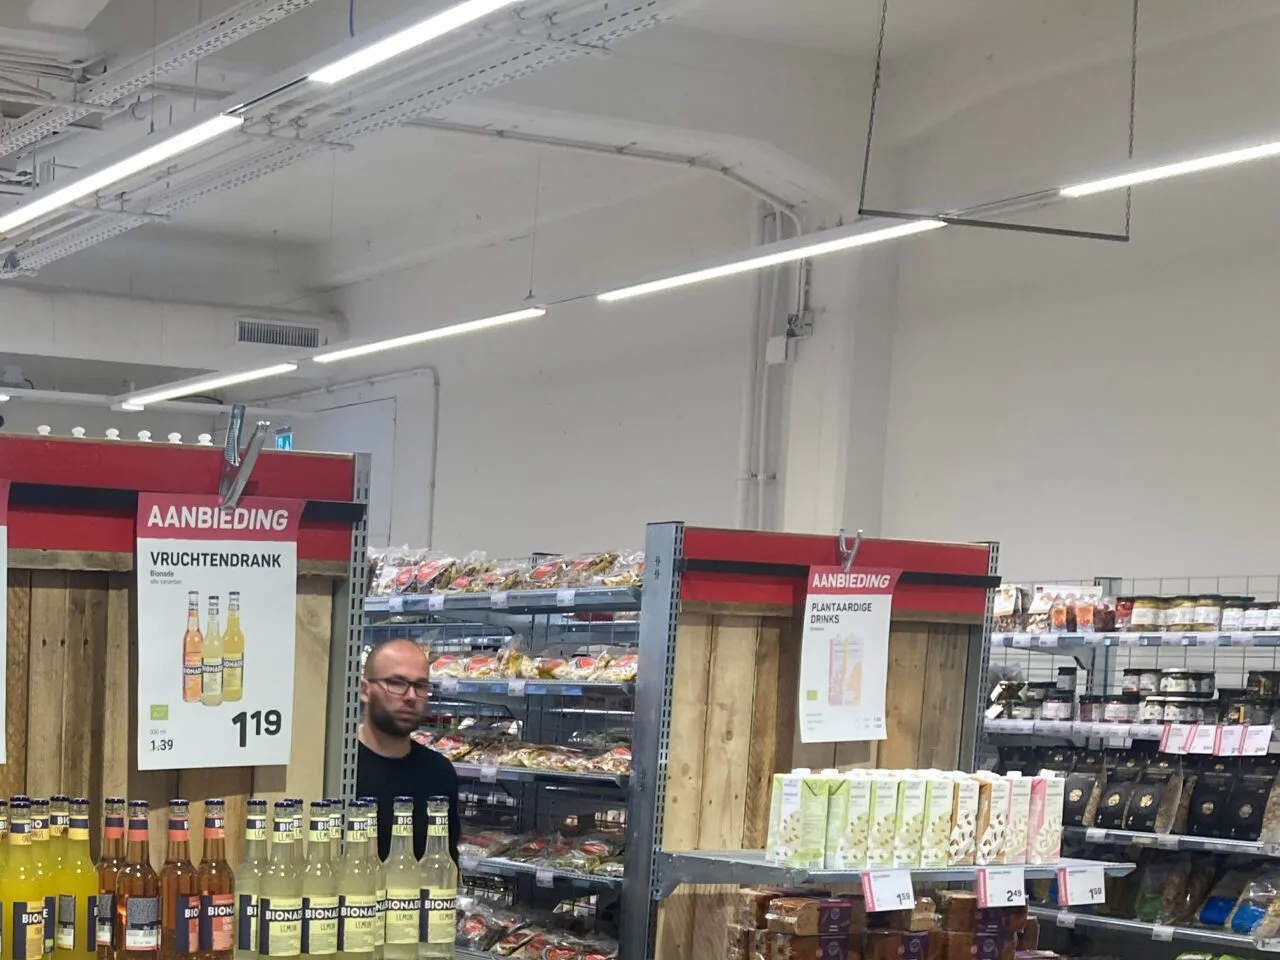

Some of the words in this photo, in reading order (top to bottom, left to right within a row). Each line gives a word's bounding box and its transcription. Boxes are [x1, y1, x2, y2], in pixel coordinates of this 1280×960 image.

[147, 505, 288, 531] AANBIEDING
[150, 552, 281, 568] VRUCHTENDRANK
[812, 573, 890, 588] AANBIEDING
[812, 603, 872, 612] PLANTAARDIGE
[811, 615, 839, 624] DRINKS
[150, 739, 173, 751] 1.39
